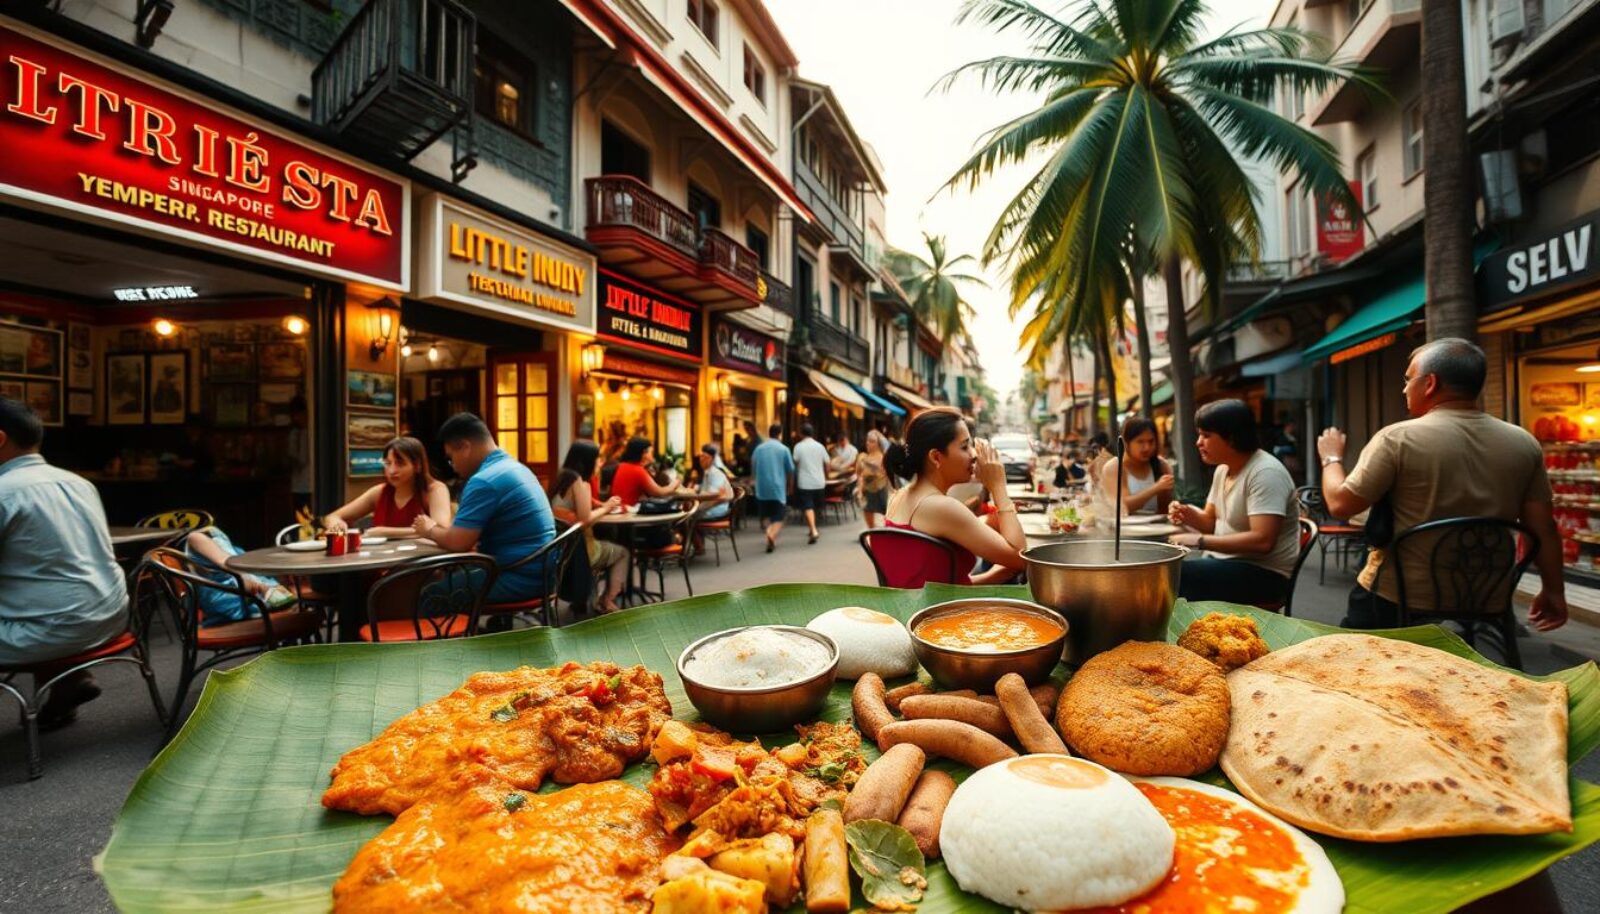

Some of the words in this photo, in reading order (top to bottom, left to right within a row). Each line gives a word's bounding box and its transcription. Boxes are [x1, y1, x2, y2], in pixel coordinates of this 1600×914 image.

[207, 208, 336, 258] RESTAURANT
[449, 222, 528, 279] LITTLE
[1506, 223, 1592, 294] SELV
